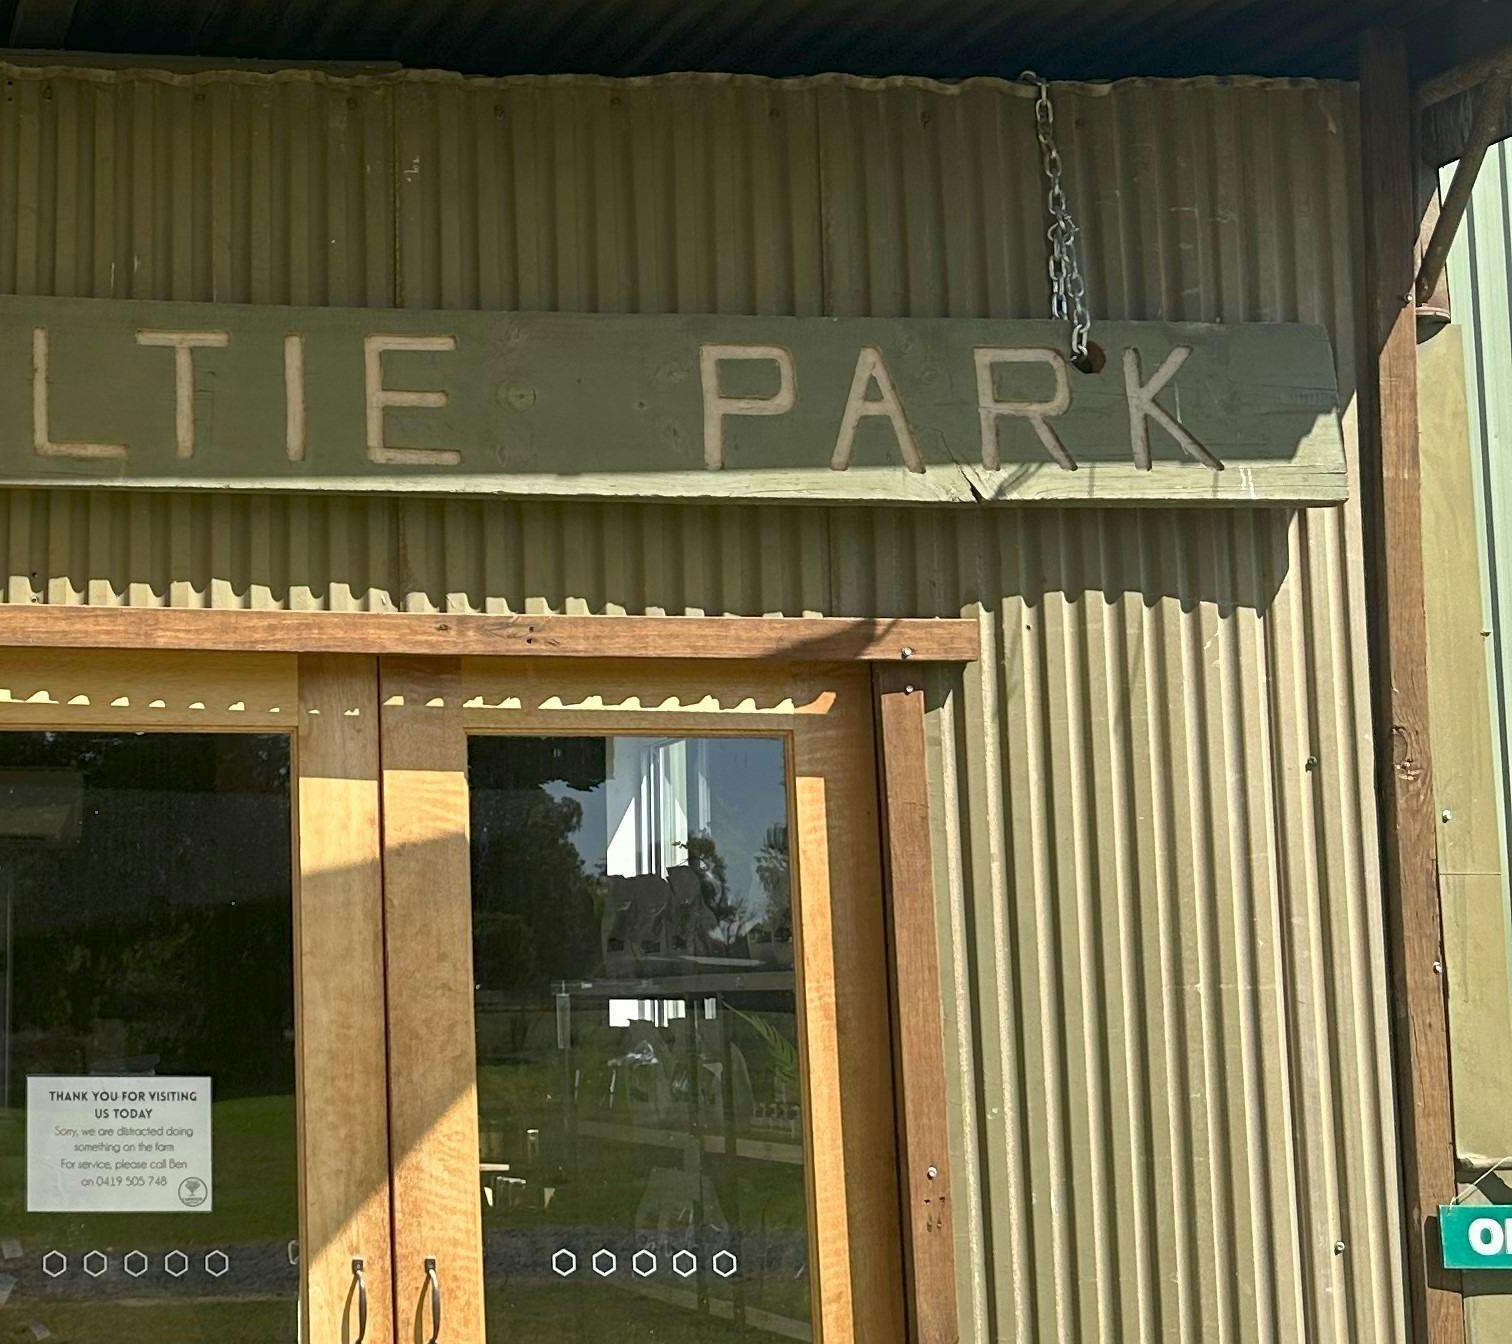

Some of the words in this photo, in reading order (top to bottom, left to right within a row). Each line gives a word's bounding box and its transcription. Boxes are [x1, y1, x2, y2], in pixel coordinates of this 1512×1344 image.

[698, 342, 1226, 474] PARK
[48, 1091, 88, 1102] THANK
[91, 1091, 118, 1102] YOU
[121, 1091, 146, 1102] FOR
[148, 1091, 198, 1102] VISITING
[94, 1108, 109, 1119] US
[113, 1108, 153, 1119] TODAY
[54, 1125, 80, 1138] Sorry,
[81, 1128, 96, 1136] we
[97, 1128, 114, 1137] are
[116, 1126, 164, 1137] distracted
[166, 1125, 194, 1138] doing
[73, 1142, 121, 1154] something
[122, 1143, 136, 1152] on
[138, 1142, 153, 1152] the
[154, 1142, 175, 1152] farm
[60, 1158, 76, 1169] For
[114, 1159, 148, 1171] please
[149, 1158, 167, 1169] call
[169, 1158, 188, 1169] Ben
[80, 1178, 94, 1187] on
[95, 1175, 123, 1187] 0419
[148, 1175, 168, 1187] 748
[1468, 1218, 1512, 1256] O
